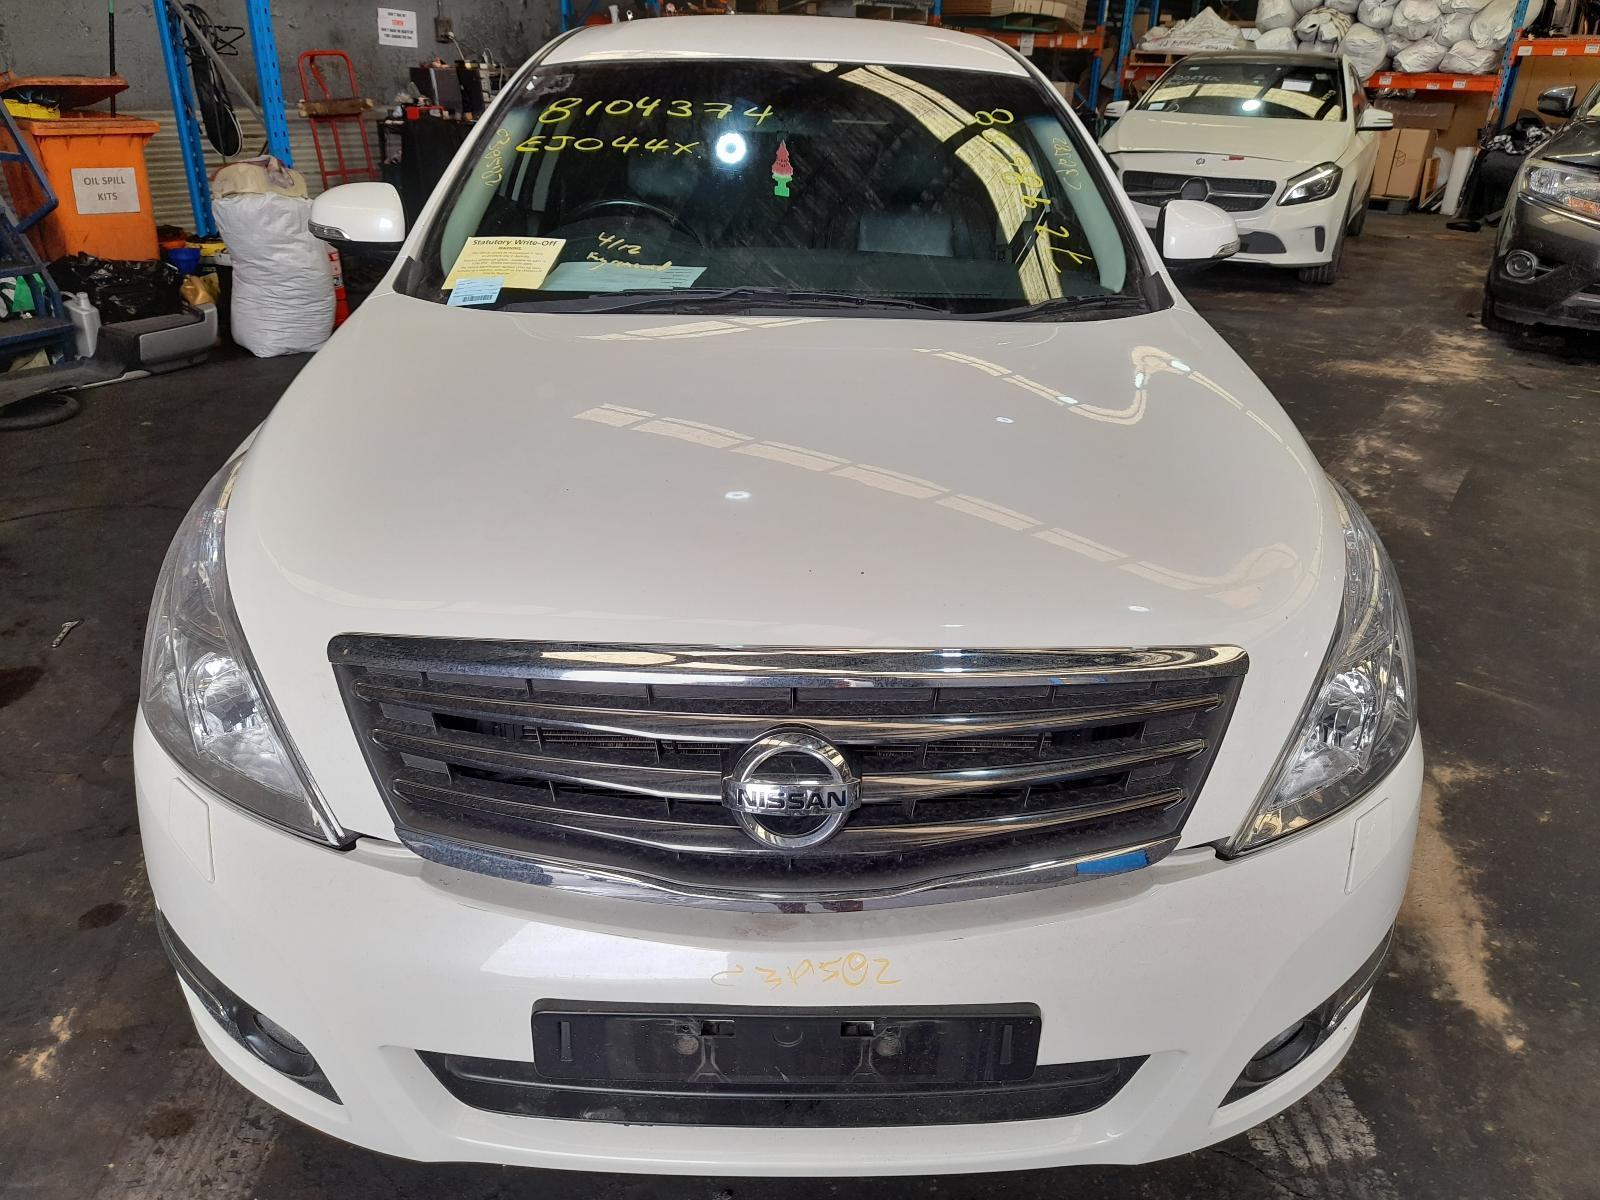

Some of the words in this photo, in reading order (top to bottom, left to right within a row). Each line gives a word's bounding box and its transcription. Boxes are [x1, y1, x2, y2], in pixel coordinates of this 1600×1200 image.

[538, 96, 774, 126] 8104374
[83, 177, 100, 186] OIL
[101, 175, 126, 185] SPILL
[97, 192, 118, 201] KITS
[472, 239, 513, 247] Statutory
[514, 239, 558, 247] Write-Off
[736, 788, 847, 811] NISSAN
